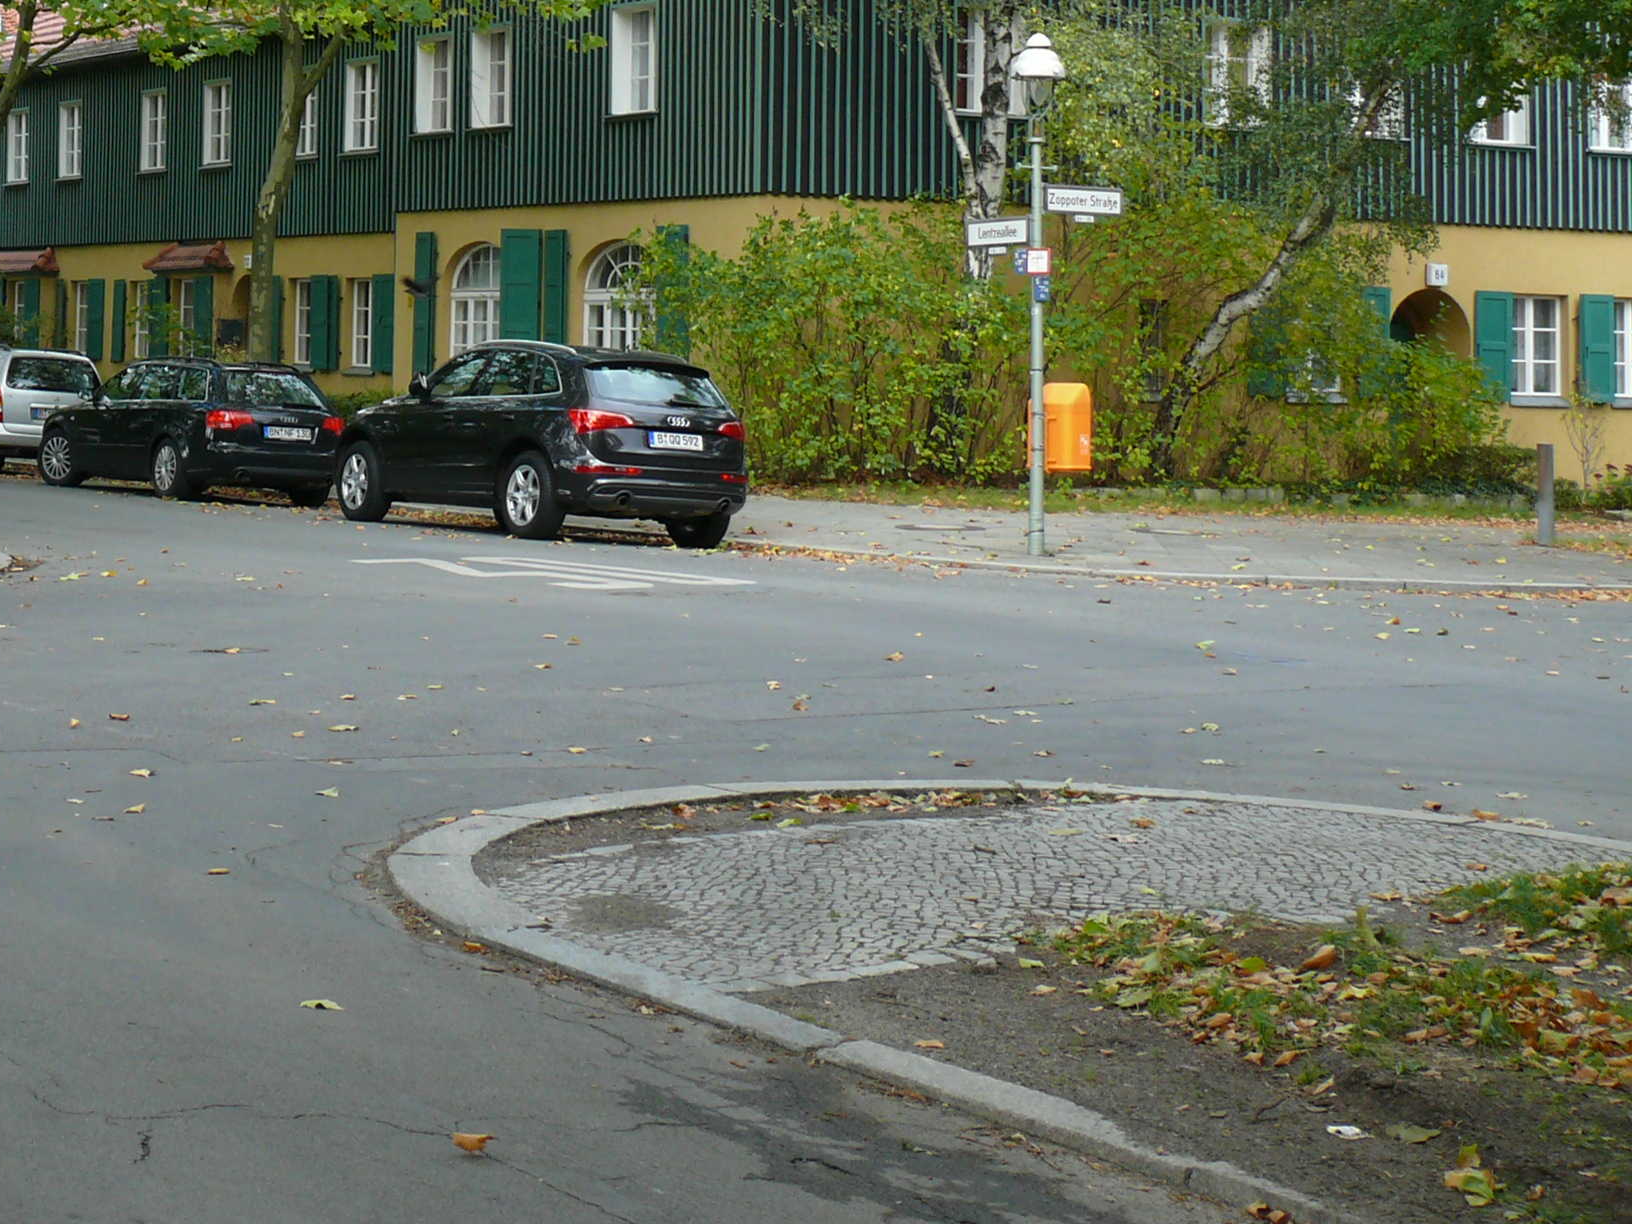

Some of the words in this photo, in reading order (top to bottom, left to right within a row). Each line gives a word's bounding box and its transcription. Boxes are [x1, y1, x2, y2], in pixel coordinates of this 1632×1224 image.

[1049, 192, 1088, 207] Zoppoter
[1090, 195, 1119, 210] Straße
[977, 225, 1017, 240] Lentzeallee
